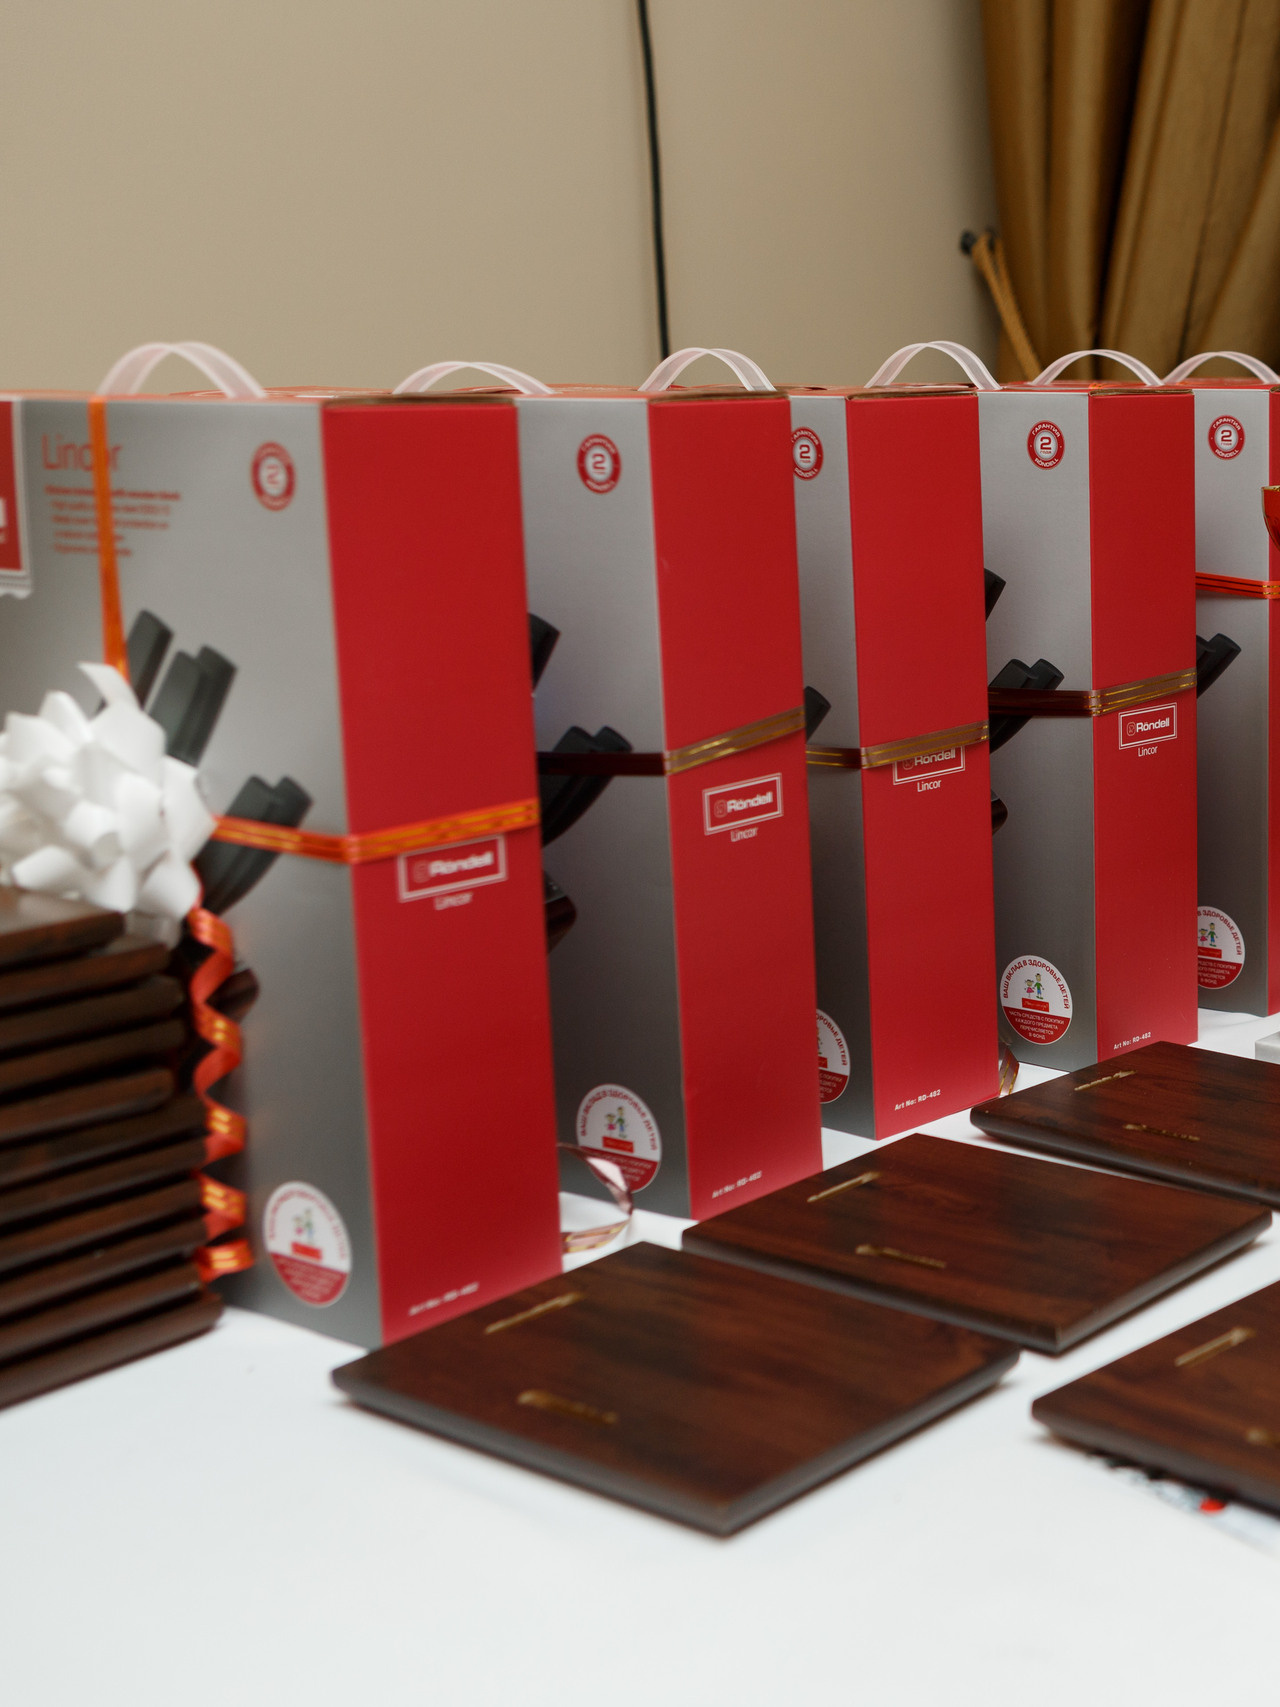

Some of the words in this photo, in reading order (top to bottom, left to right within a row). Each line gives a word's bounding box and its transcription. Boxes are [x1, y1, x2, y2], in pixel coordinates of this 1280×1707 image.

[1032, 423, 1060, 437] ГАРАНТИЯ
[1221, 430, 1232, 442] 2
[1040, 436, 1052, 450] 2
[42, 434, 124, 472] Lincr
[799, 444, 811, 459] 2
[592, 453, 606, 470] 2
[1136, 717, 1170, 733] Röndell
[1137, 746, 1158, 757] Lincor
[917, 780, 942, 793] Lincor
[730, 827, 759, 842] Lincor
[1202, 910, 1235, 932] ЗДОРОВЬЕ
[1231, 932, 1243, 956] ДЕТЕЙ
[1006, 962, 1024, 981] ВКЛАД
[1028, 959, 1062, 984] ЗДОРОВЬЕ
[1058, 983, 1071, 1010] ДЕТЕЙ
[816, 1014, 839, 1037] ОРОВЬЕ
[1015, 1018, 1036, 1026] КАЖДОГО
[1035, 1022, 1059, 1030] ПРЕДМЕТА
[1021, 1012, 1041, 1021] СРЕДСТВ
[1044, 1017, 1065, 1025] ПОКУПКИ
[1020, 1024, 1054, 1035] ПЕРЕЧИСЛЯЕТСЯ
[1132, 1031, 1152, 1043] RD-482
[894, 1102, 905, 1111] Art
[917, 1089, 941, 1102] RD-482
